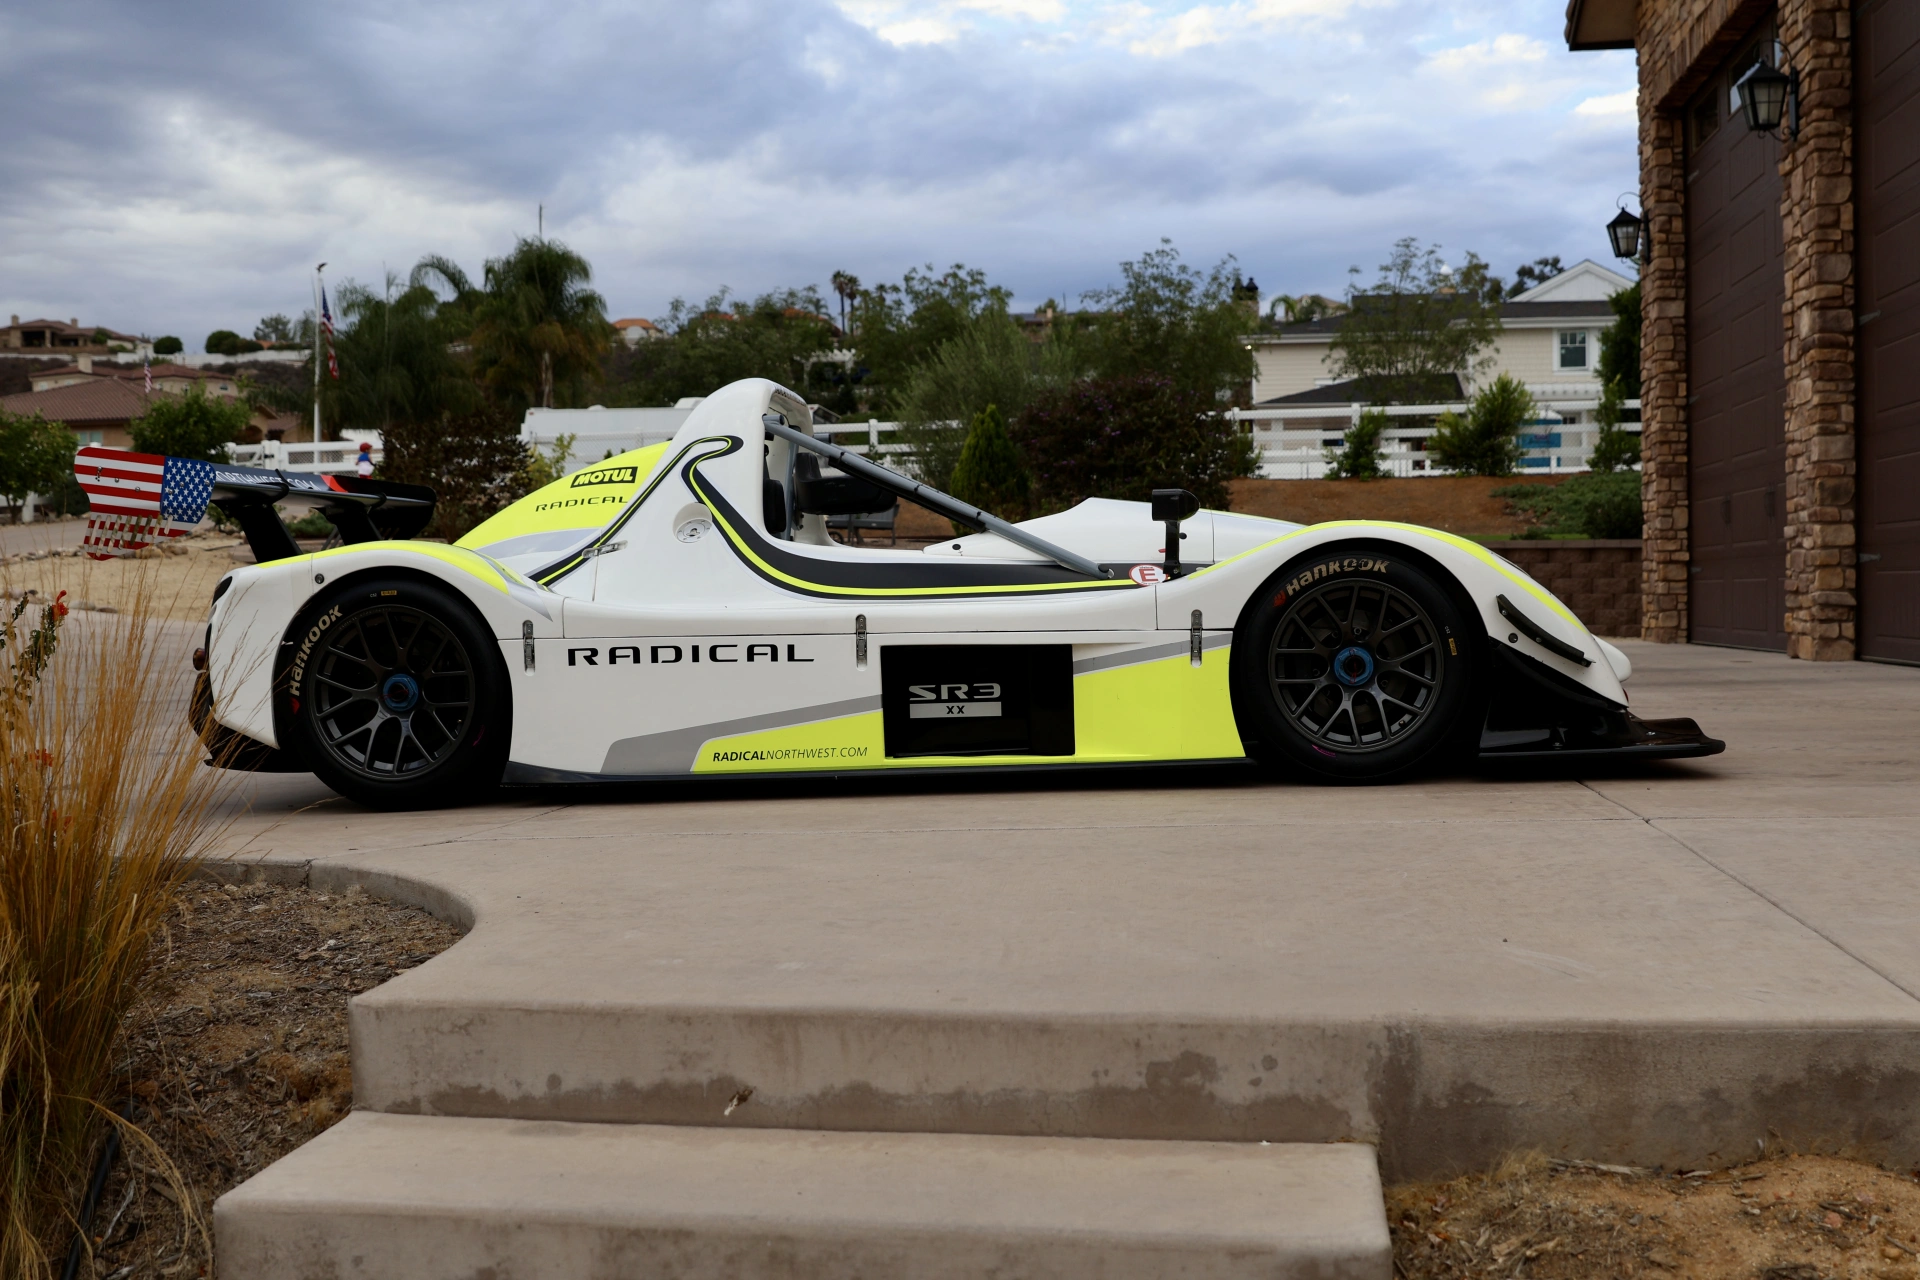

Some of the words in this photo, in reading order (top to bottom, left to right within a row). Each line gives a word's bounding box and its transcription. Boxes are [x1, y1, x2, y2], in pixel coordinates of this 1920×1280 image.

[573, 468, 634, 486] MOTUL
[535, 496, 629, 512] RADICAL
[1139, 568, 1159, 582] E
[567, 643, 815, 666] RADICAL
[908, 682, 1001, 701] SR3
[945, 704, 966, 715] XX
[713, 746, 868, 762] RADICALNORTHWEST.COM
